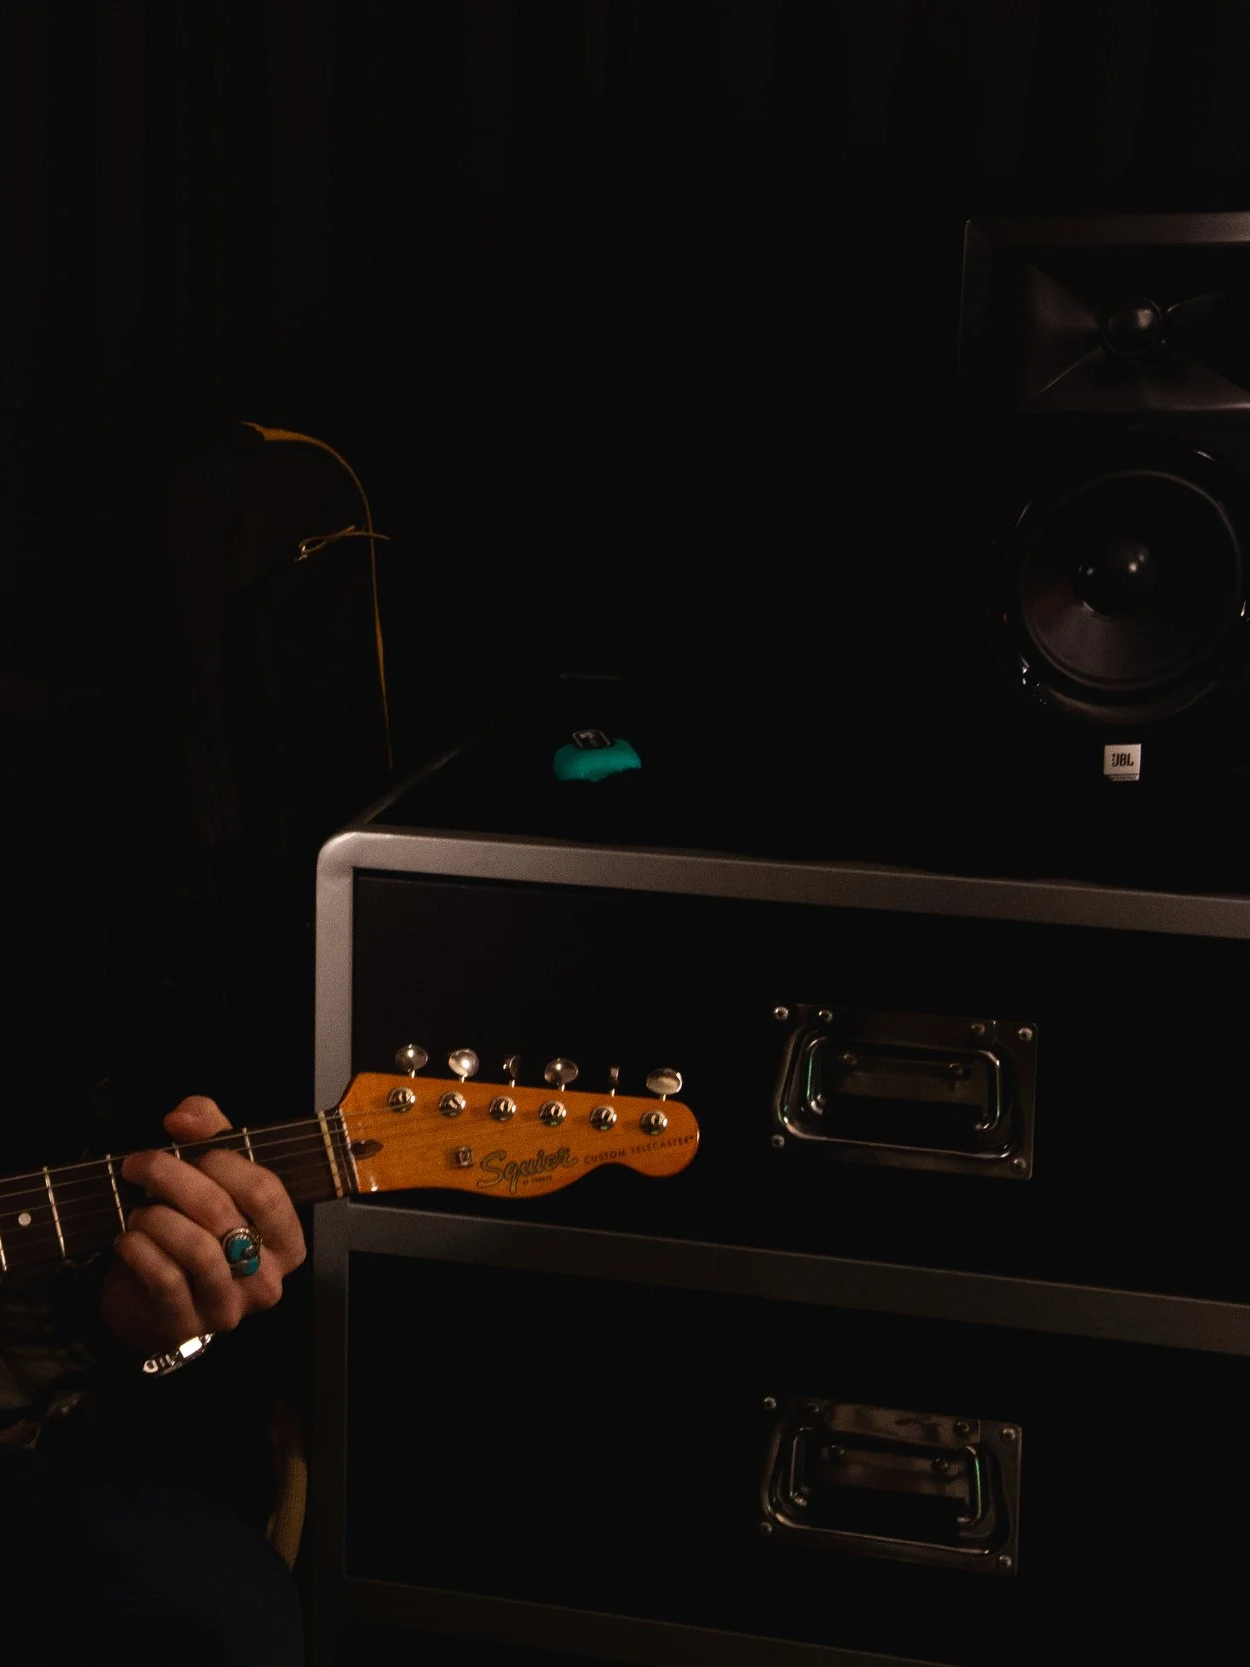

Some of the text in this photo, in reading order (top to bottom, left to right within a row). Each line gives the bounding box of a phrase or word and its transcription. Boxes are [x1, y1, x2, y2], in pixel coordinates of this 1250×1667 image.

[1111, 752, 1134, 767] JBL
[584, 1149, 627, 1164] CUSTOM
[476, 1147, 578, 1193] Squier
